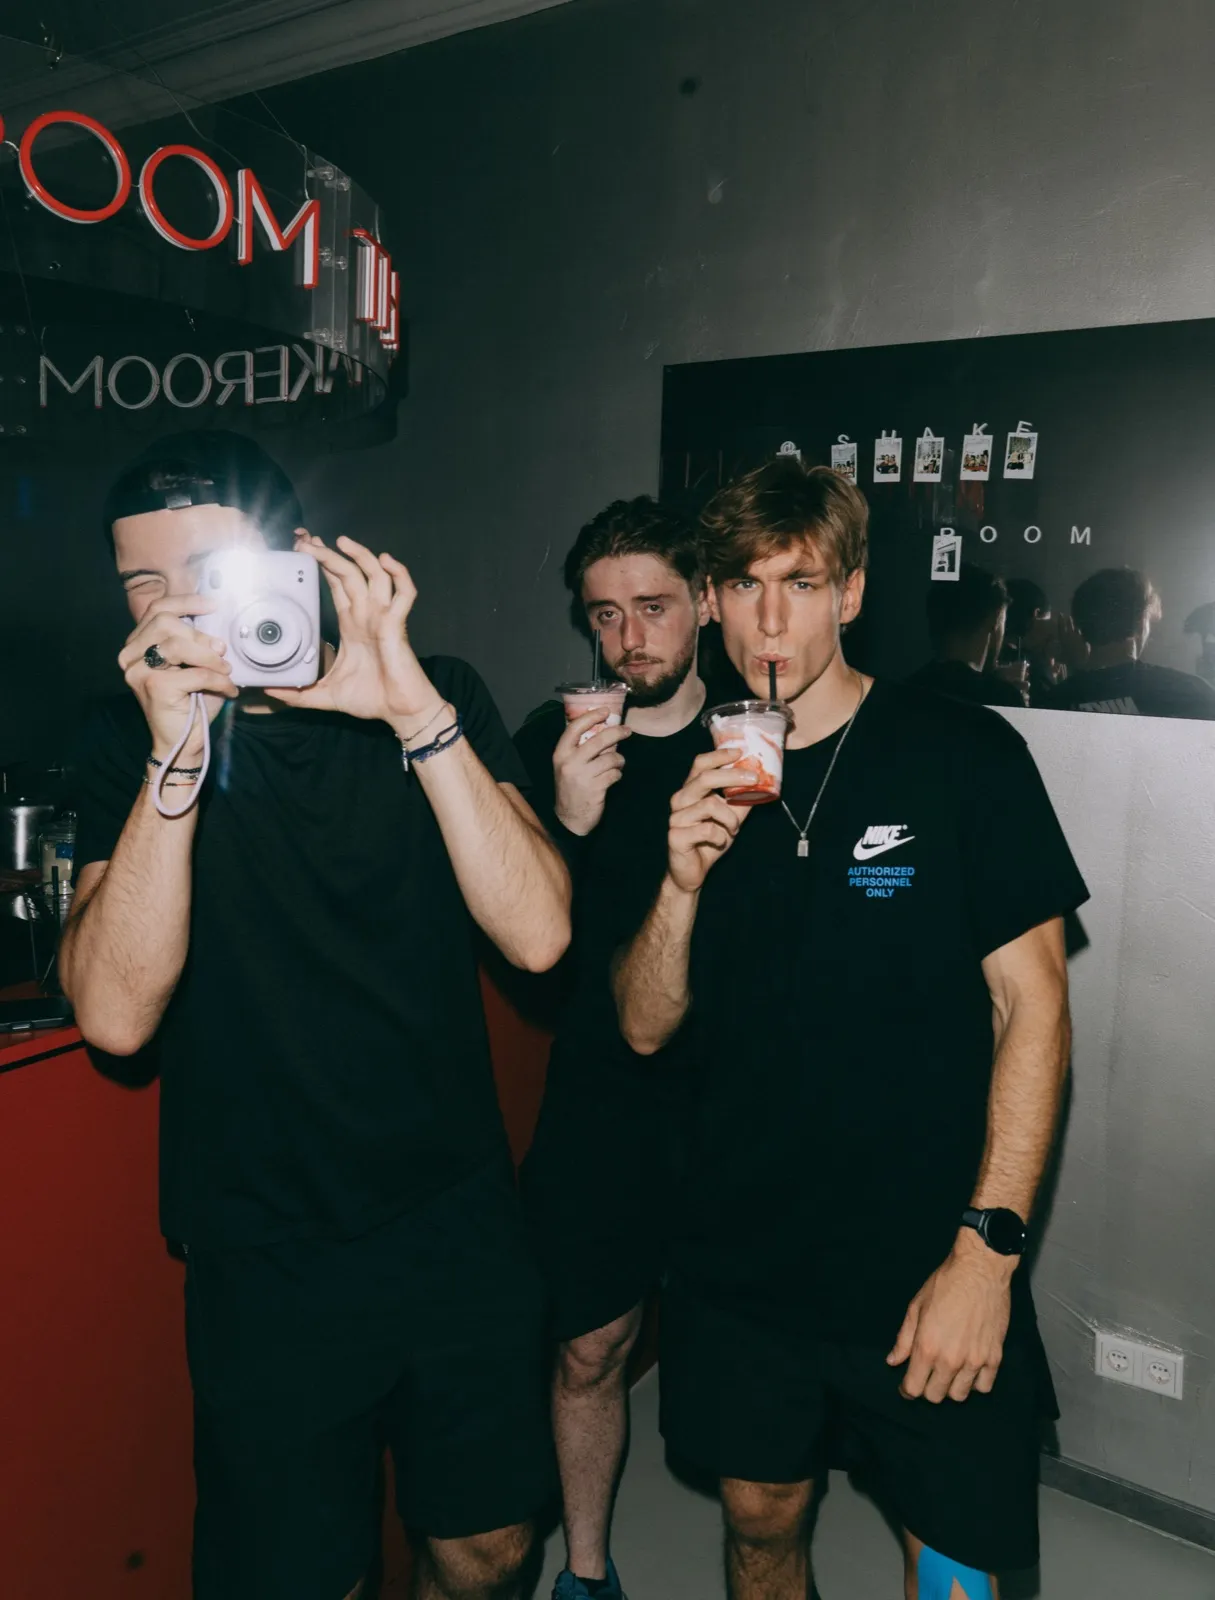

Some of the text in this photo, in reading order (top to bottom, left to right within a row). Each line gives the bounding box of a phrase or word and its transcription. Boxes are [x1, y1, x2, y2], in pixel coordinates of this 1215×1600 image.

[0, 110, 320, 289] OOM
[861, 825, 902, 845] NIKE
[847, 866, 915, 876] AUTHORIZED
[849, 877, 912, 887] PERSONNEL
[865, 888, 895, 898] ONLY
